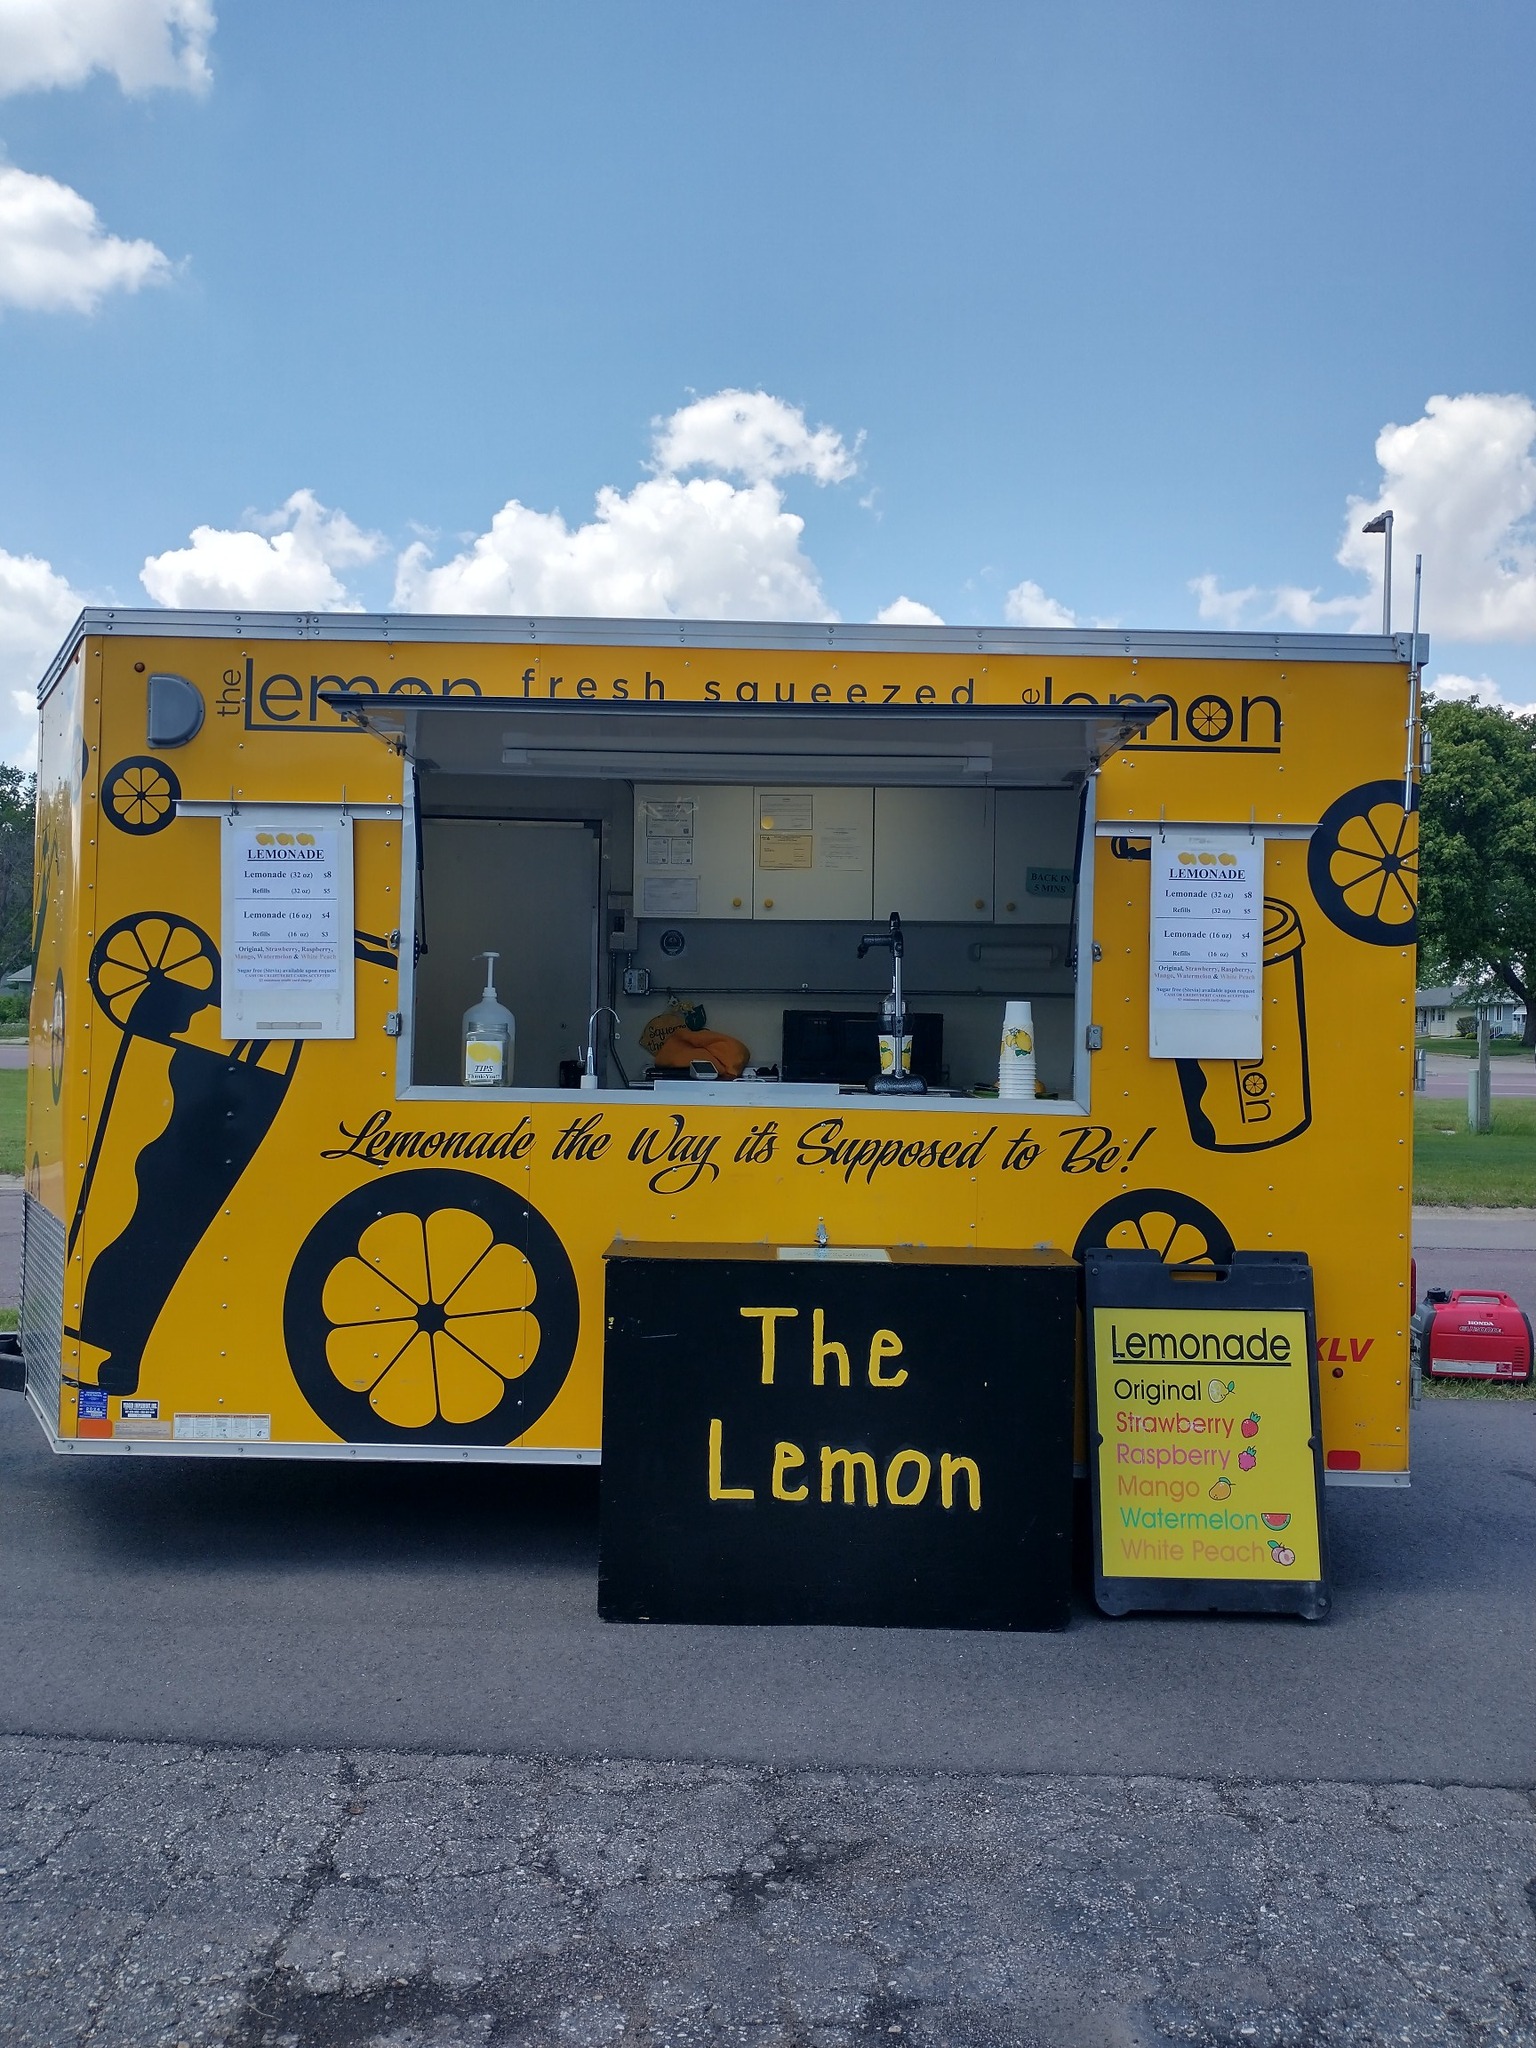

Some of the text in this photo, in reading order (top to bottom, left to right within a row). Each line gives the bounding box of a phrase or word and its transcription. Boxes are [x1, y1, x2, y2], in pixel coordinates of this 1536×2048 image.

[215, 669, 241, 717] the
[522, 668, 665, 700] fresh
[248, 849, 325, 860] LEMONADE
[244, 870, 287, 878] Lemonade
[324, 870, 332, 878] $8
[1031, 872, 1070, 882] BACK IN
[1169, 868, 1246, 880] LEMONADE
[1034, 884, 1066, 892] 5 MINS
[1165, 890, 1208, 898] Lemonade
[1210, 892, 1222, 900] (32
[1223, 892, 1234, 900] oz)
[244, 911, 286, 919] Lemonade
[289, 912, 300, 920] (16
[301, 912, 312, 920] oz)
[1164, 930, 1207, 938] Lemonade
[1221, 932, 1232, 940] oz)
[1242, 932, 1250, 940] $4
[301, 946, 334, 954] Raspberry,
[1220, 966, 1253, 974] Raspberry,
[475, 1065, 494, 1073] TIPS
[320, 1109, 537, 1166] Lemonade
[552, 1113, 613, 1162] the
[627, 1114, 721, 1194] Way
[796, 1116, 998, 1185] Supposed
[1002, 1127, 1047, 1171] to
[1058, 1126, 1157, 1174] Be!
[740, 1307, 909, 1387] The
[1111, 1325, 1291, 1362] Lemonade
[1114, 1379, 1202, 1405] Original
[1116, 1411, 1234, 1438] Strawberry
[709, 1419, 981, 1511] Lemon
[1117, 1443, 1231, 1470] Raspberry
[1118, 1475, 1200, 1503] Mango
[1120, 1507, 1258, 1531] Watermelon
[1120, 1538, 1265, 1562] White Peach
